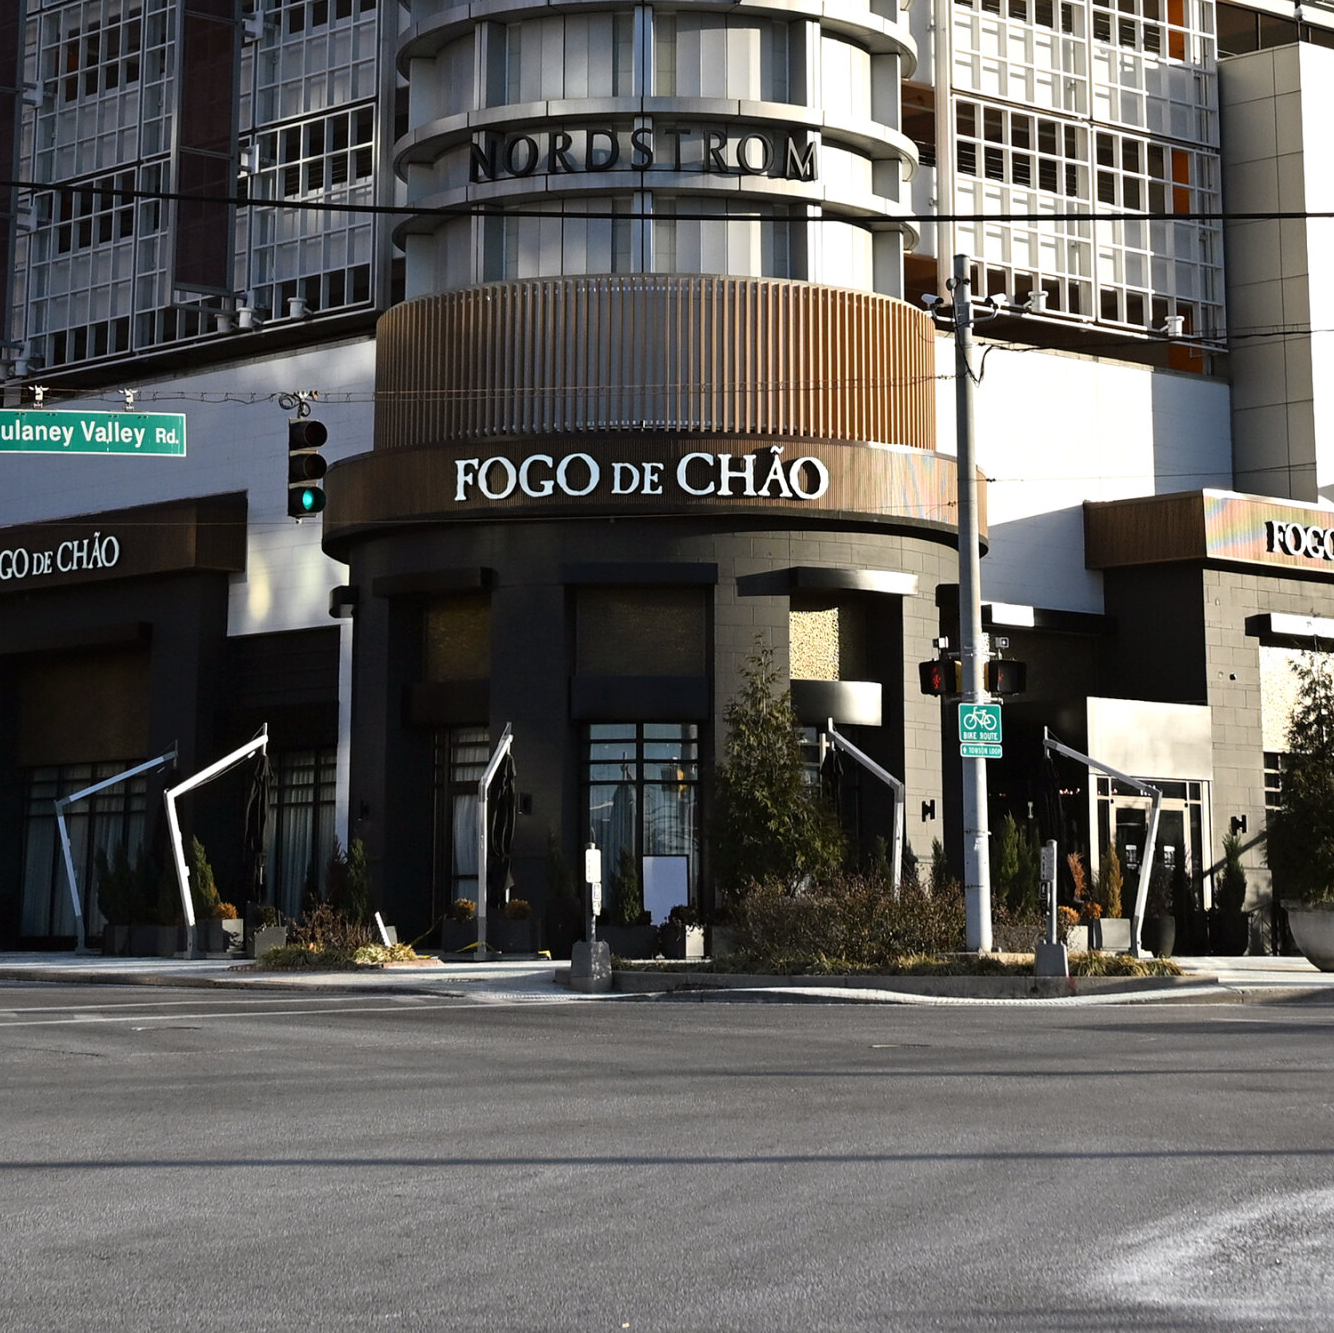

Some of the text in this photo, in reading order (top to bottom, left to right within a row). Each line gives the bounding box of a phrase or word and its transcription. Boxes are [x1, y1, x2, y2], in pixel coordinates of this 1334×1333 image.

[470, 128, 819, 182] NORDSTROM
[80, 421, 145, 448] Valley
[156, 429, 179, 445] Rd.
[454, 446, 829, 502] FOGO DE CHÃO
[32, 550, 53, 576] DE
[57, 531, 120, 573] CHÃO
[963, 731, 998, 741] BIKE ROUTE
